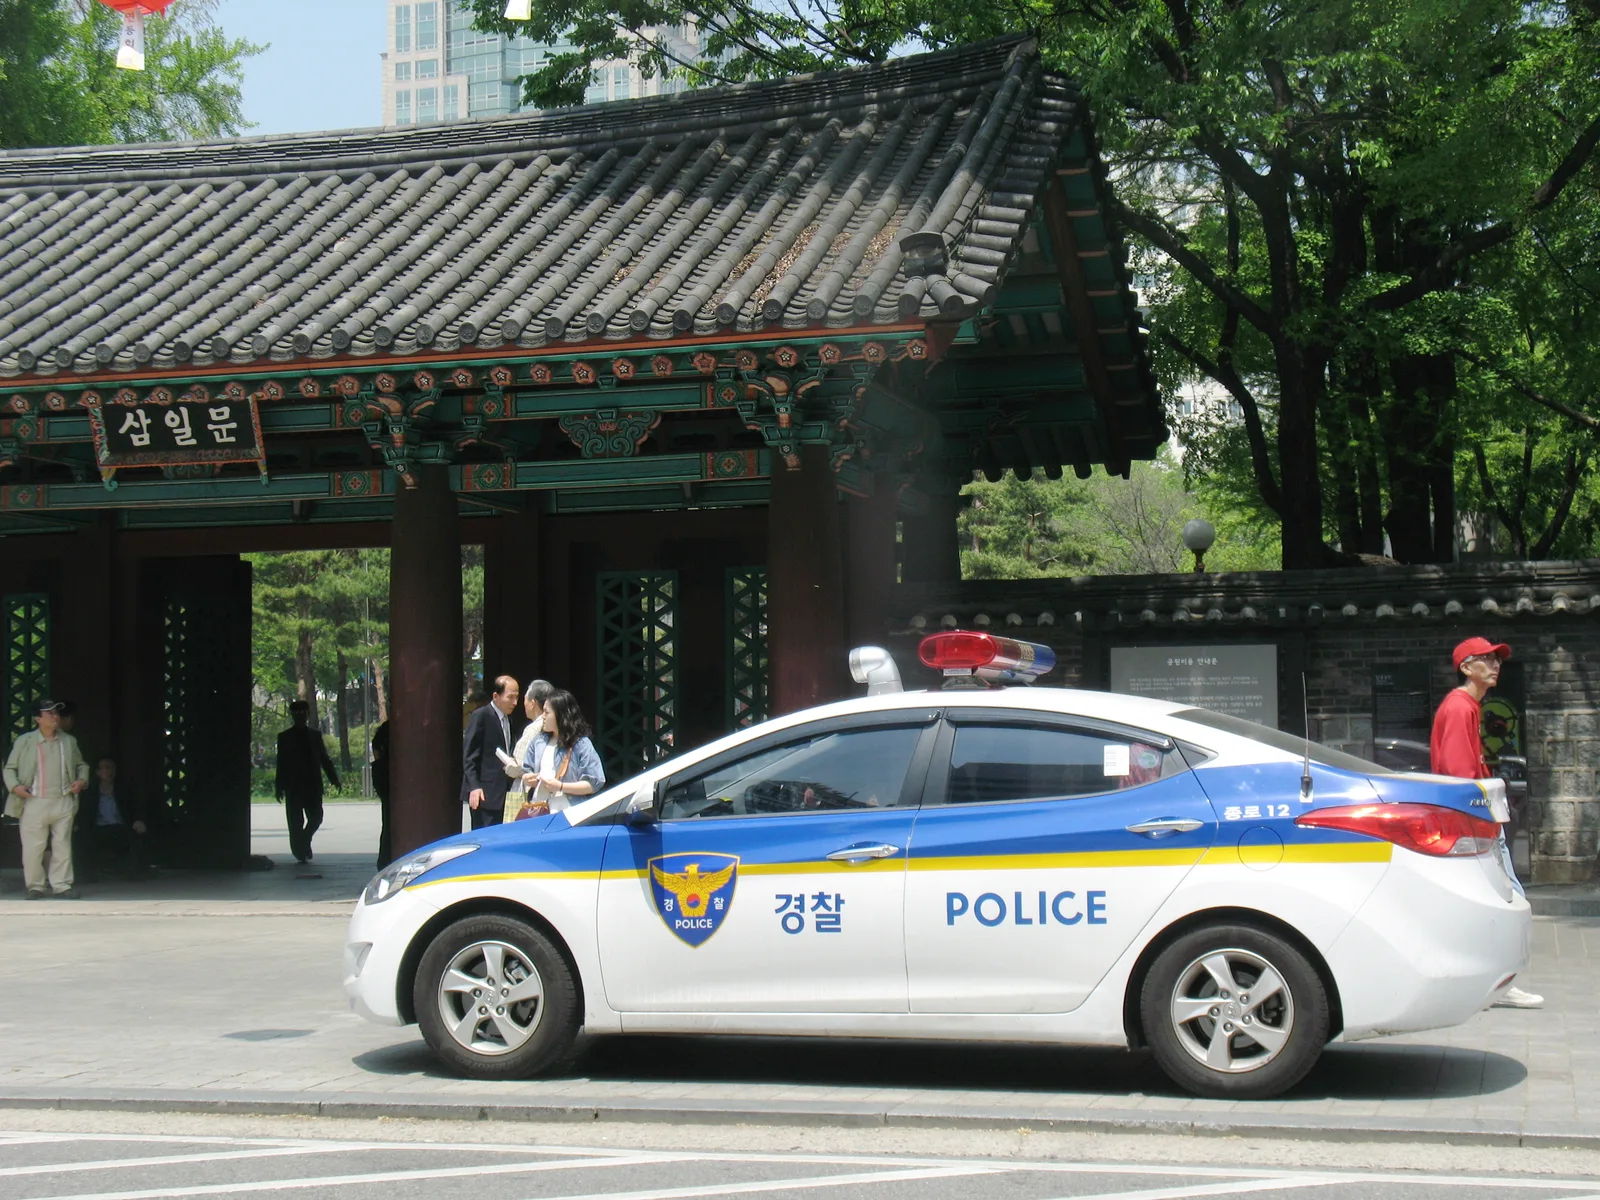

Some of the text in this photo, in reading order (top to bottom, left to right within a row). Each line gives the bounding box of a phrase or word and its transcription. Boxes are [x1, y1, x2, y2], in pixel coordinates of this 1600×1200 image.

[118, 406, 237, 446] 삼일문
[1223, 804, 1290, 820] 종로 12
[675, 918, 713, 929] POLICE
[774, 891, 845, 934] 경찰
[946, 890, 1107, 927] POLICE
